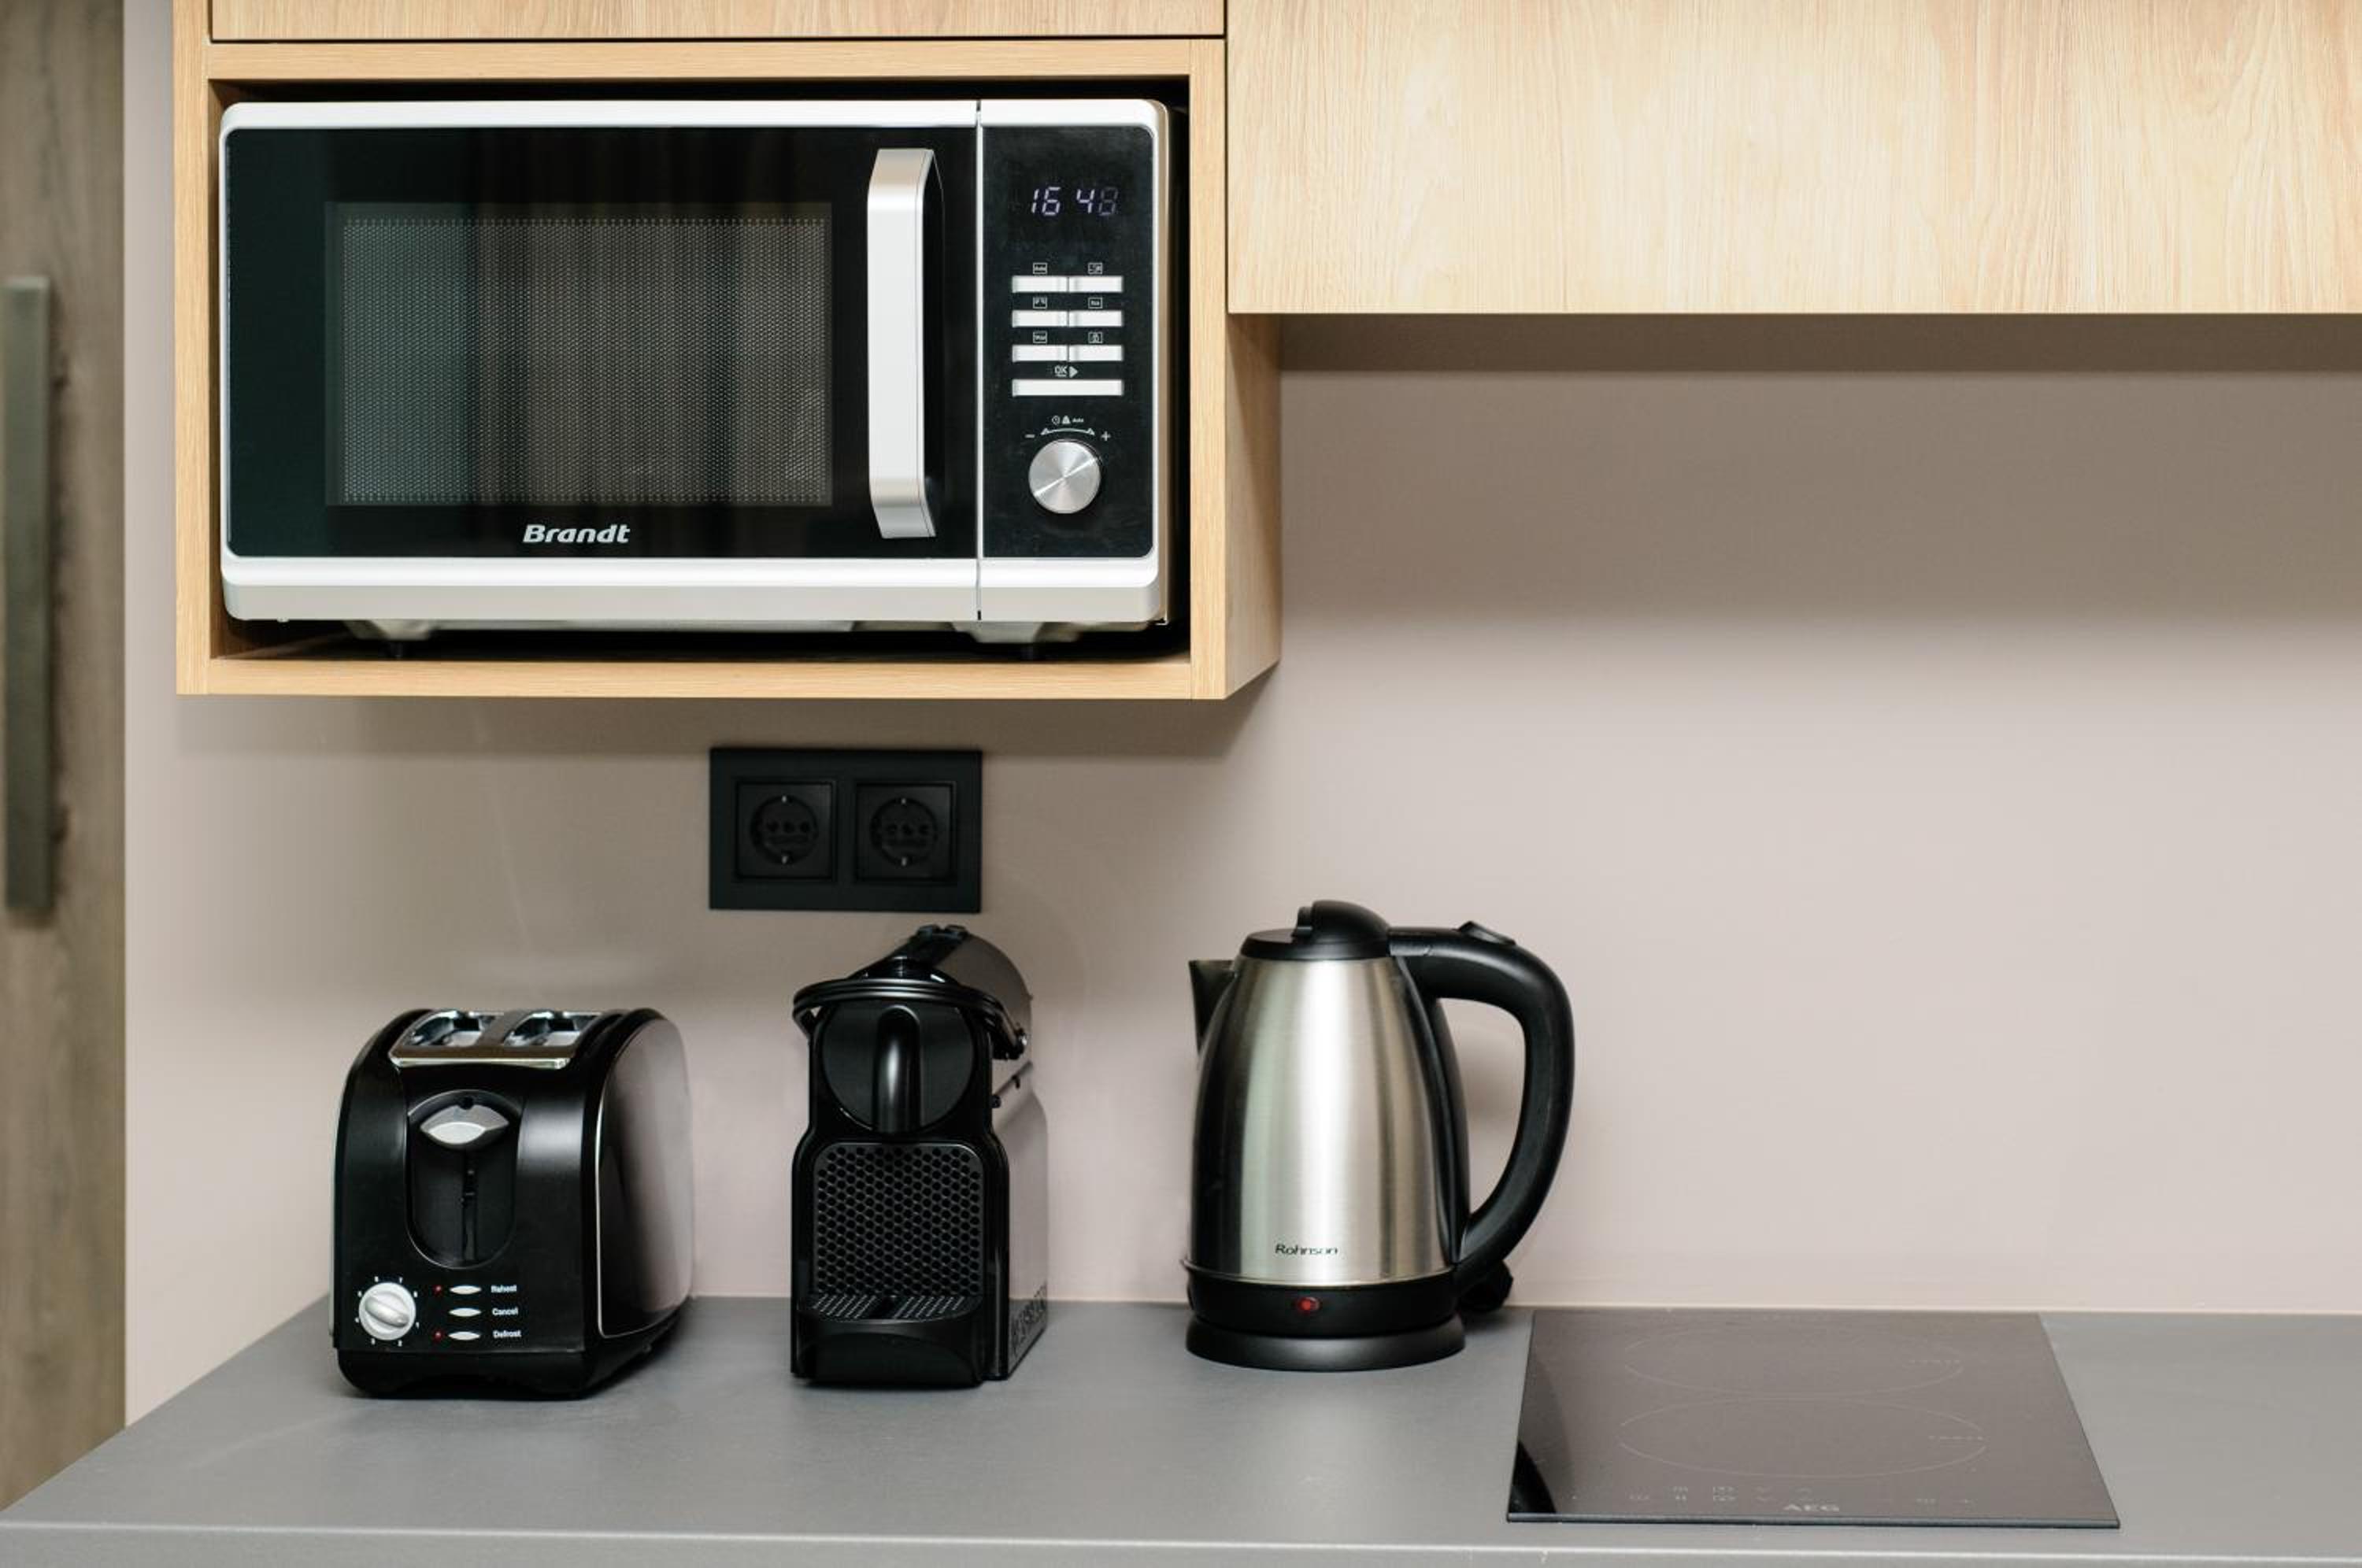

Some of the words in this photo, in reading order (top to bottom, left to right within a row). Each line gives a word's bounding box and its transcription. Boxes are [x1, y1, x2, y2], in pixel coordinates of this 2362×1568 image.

[1031, 186, 1062, 216] 16
[522, 523, 631, 544] Brandt
[1274, 1243, 1338, 1256] Rohnson
[492, 1307, 519, 1316] Cancel
[493, 1329, 522, 1338] Defrost
[1783, 1503, 1840, 1512] AEG
